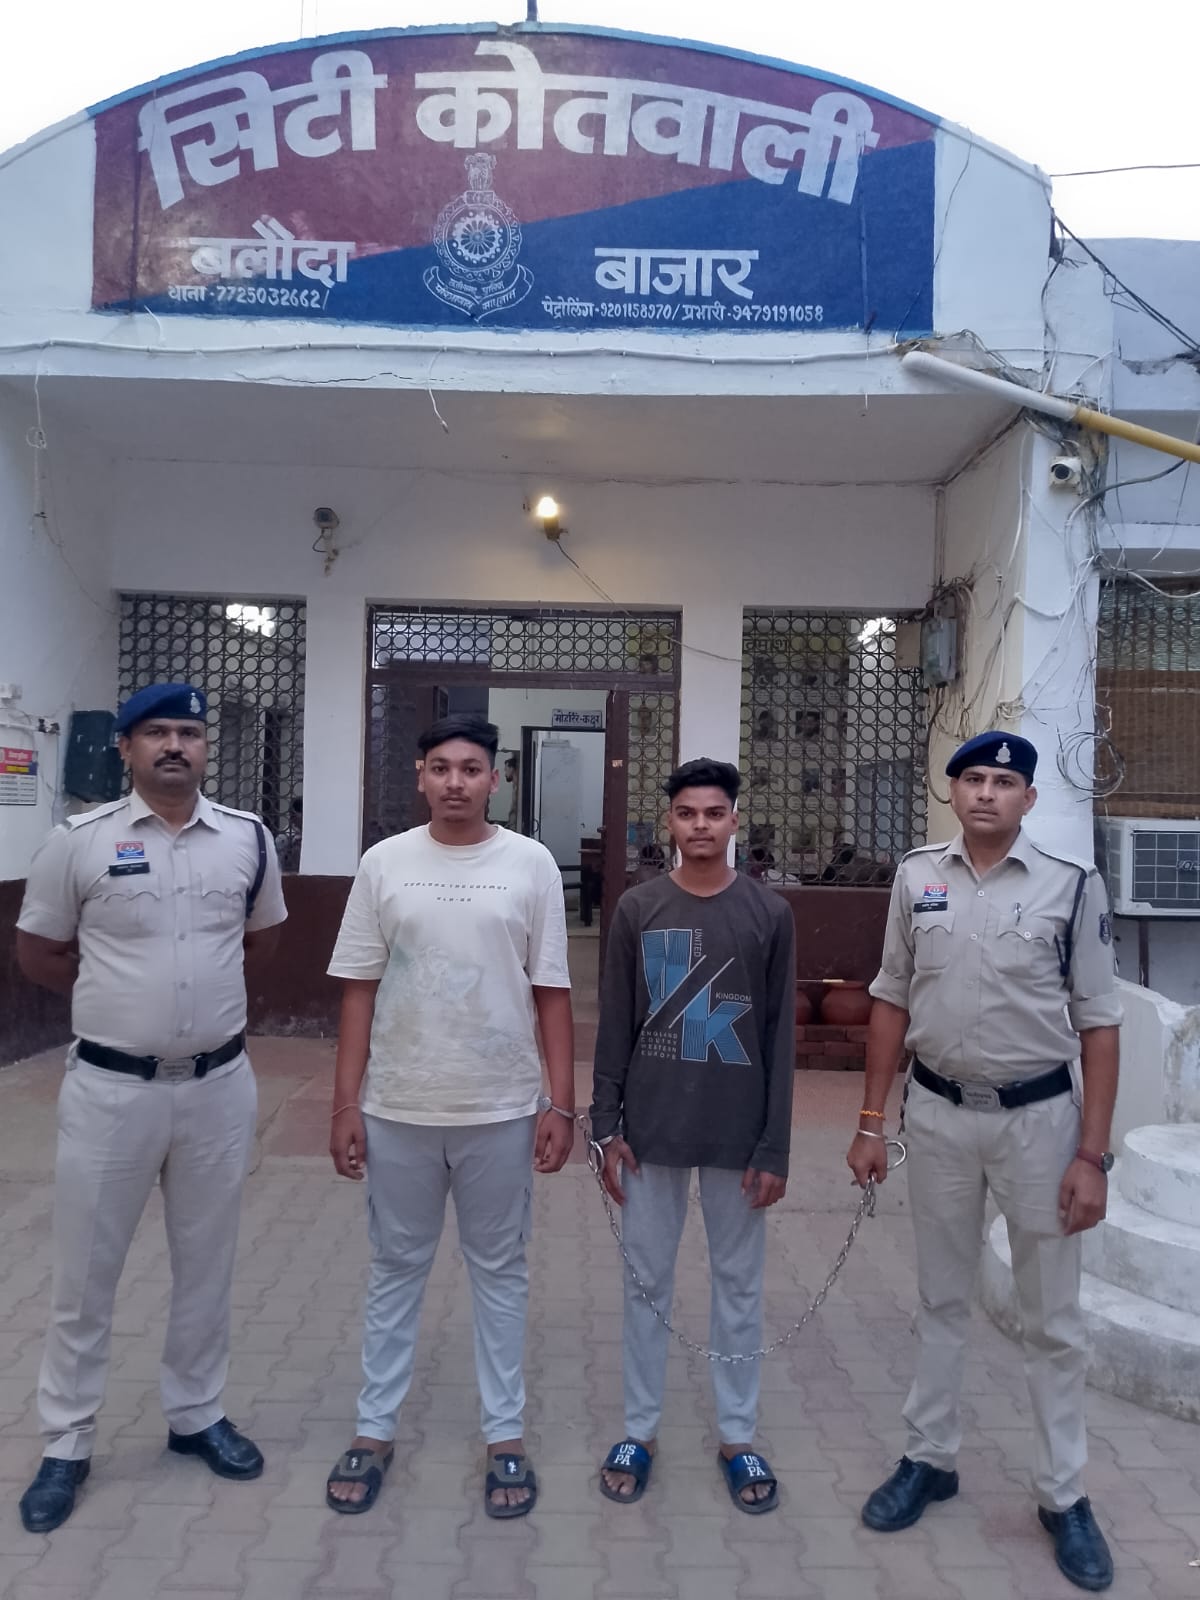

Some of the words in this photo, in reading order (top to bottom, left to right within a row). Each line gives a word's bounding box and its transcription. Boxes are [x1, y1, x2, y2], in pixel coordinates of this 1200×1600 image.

[138, 50, 388, 210] सिटी
[415, 40, 880, 205] कोतवाली
[188, 214, 356, 288] बलौदा
[595, 247, 759, 300] बाजार
[694, 928, 703, 958] UNITED
[715, 991, 752, 1002] KINGDOM
[619, 1443, 637, 1456] US
[613, 1454, 632, 1466] PA
[742, 1455, 760, 1467] US
[747, 1466, 766, 1478] PA
